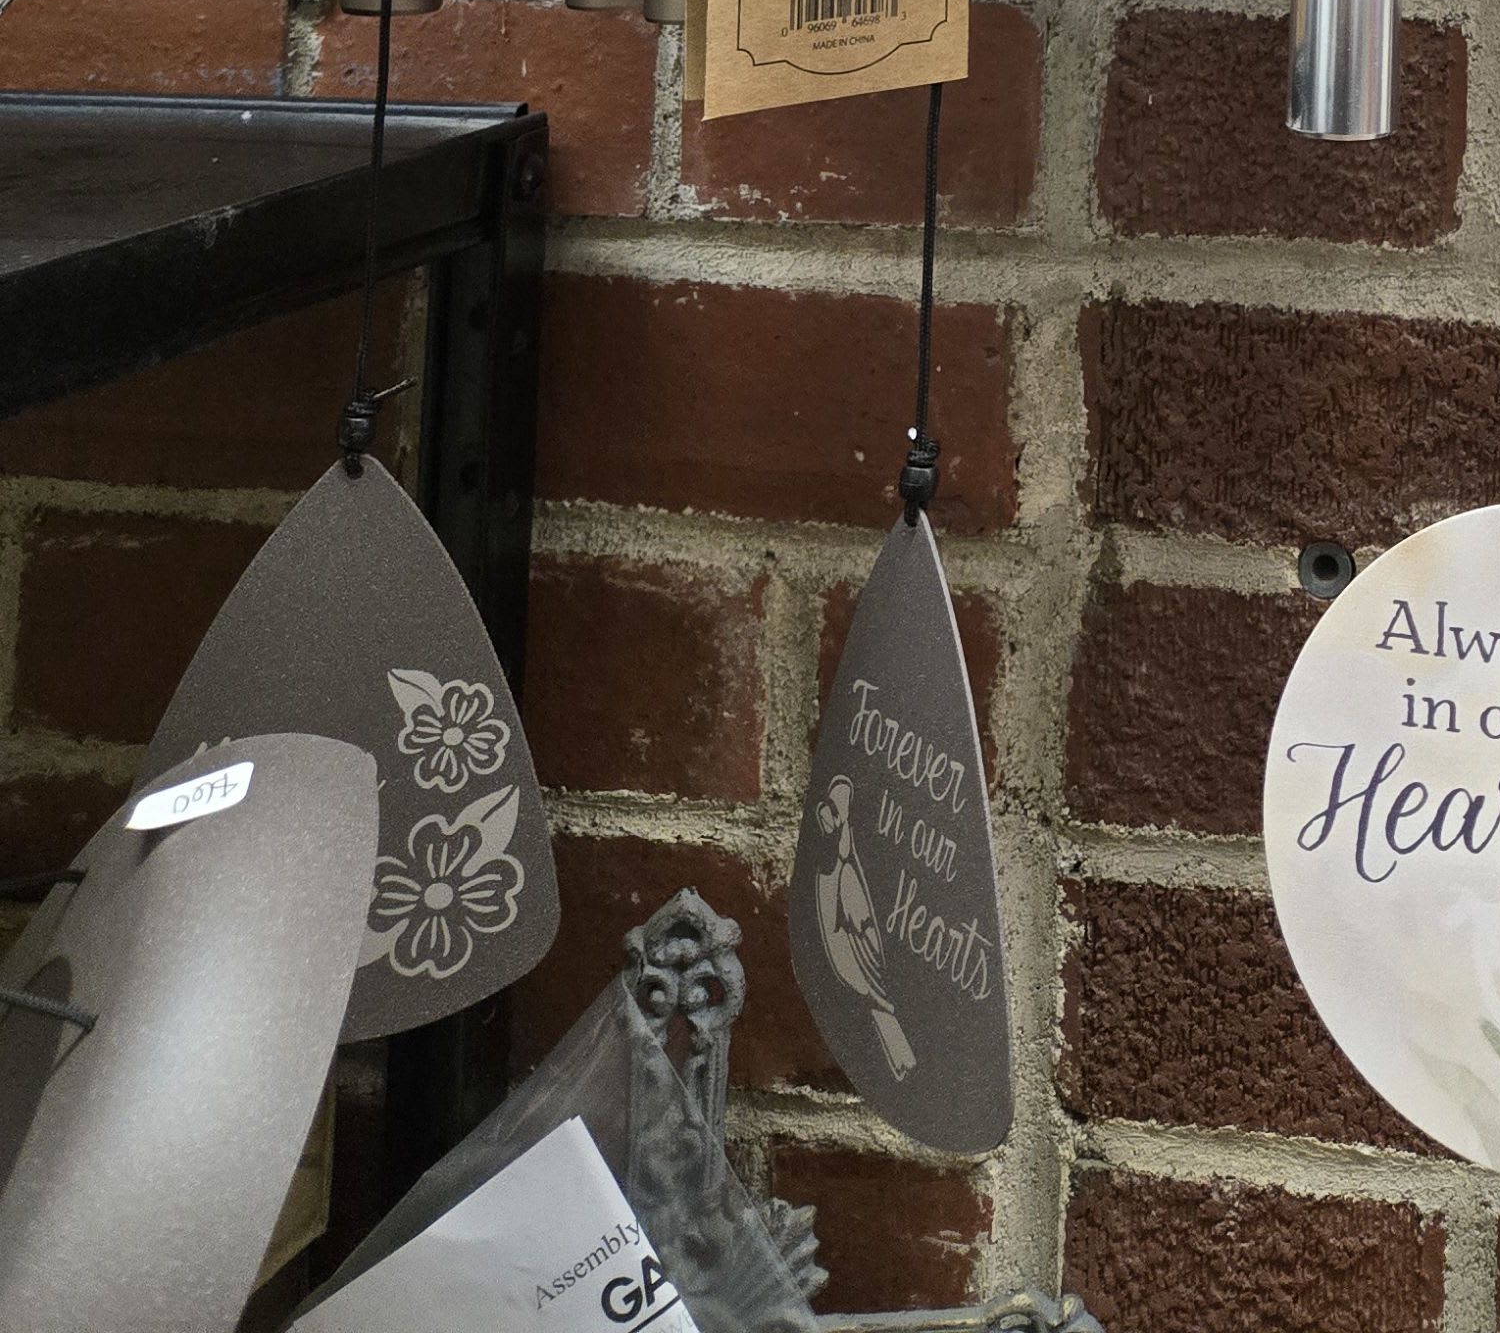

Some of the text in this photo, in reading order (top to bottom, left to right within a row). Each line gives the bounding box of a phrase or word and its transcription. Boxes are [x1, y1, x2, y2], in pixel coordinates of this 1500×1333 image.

[782, 11, 907, 38] 0 96069 64698 3
[812, 34, 875, 51] MADE IN CHINA
[850, 679, 967, 814] Forever
[1401, 678, 1461, 733] in
[878, 789, 957, 882] in our
[887, 869, 993, 1000] Hearts
[535, 1220, 641, 1311] Assembly
